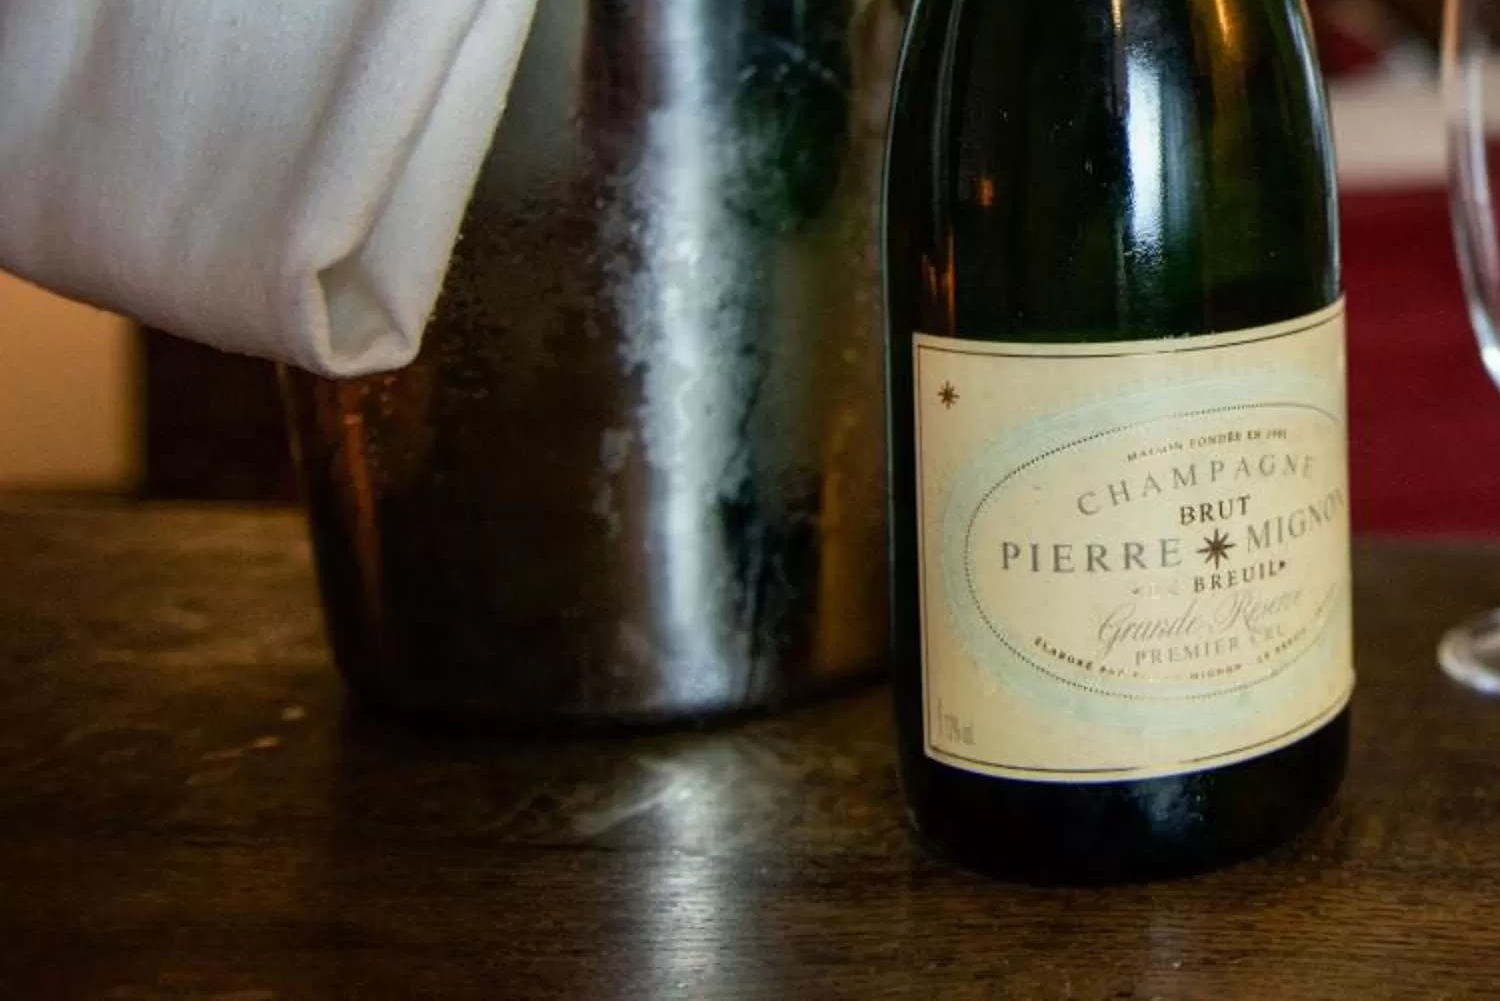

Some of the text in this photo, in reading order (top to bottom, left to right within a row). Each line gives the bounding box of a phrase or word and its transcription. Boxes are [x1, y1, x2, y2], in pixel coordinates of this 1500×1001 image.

[1076, 453, 1319, 516] CHAMPAGNE
[1179, 495, 1252, 526] BRUT
[1001, 538, 1183, 574] PIERRE
[1134, 636, 1240, 667] PREMIER
